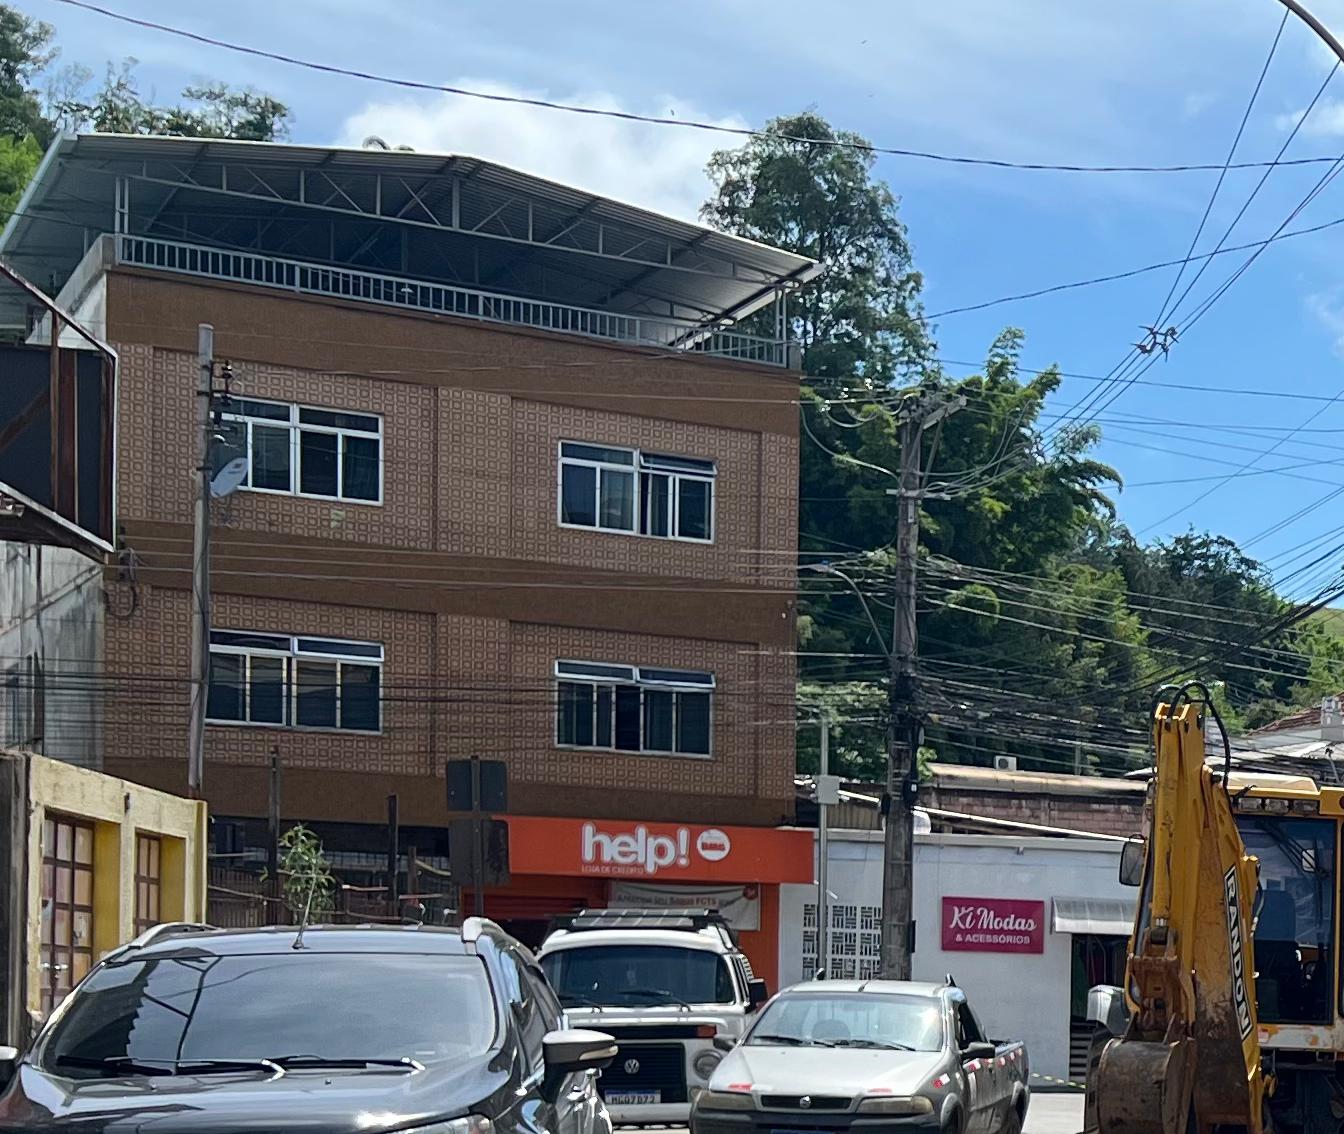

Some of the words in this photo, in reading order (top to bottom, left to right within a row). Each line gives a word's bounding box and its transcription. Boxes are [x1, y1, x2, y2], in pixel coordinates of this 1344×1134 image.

[581, 821, 690, 874] help!
[977, 907, 1037, 931] Modas
[1227, 876, 1250, 1030] RANDON
